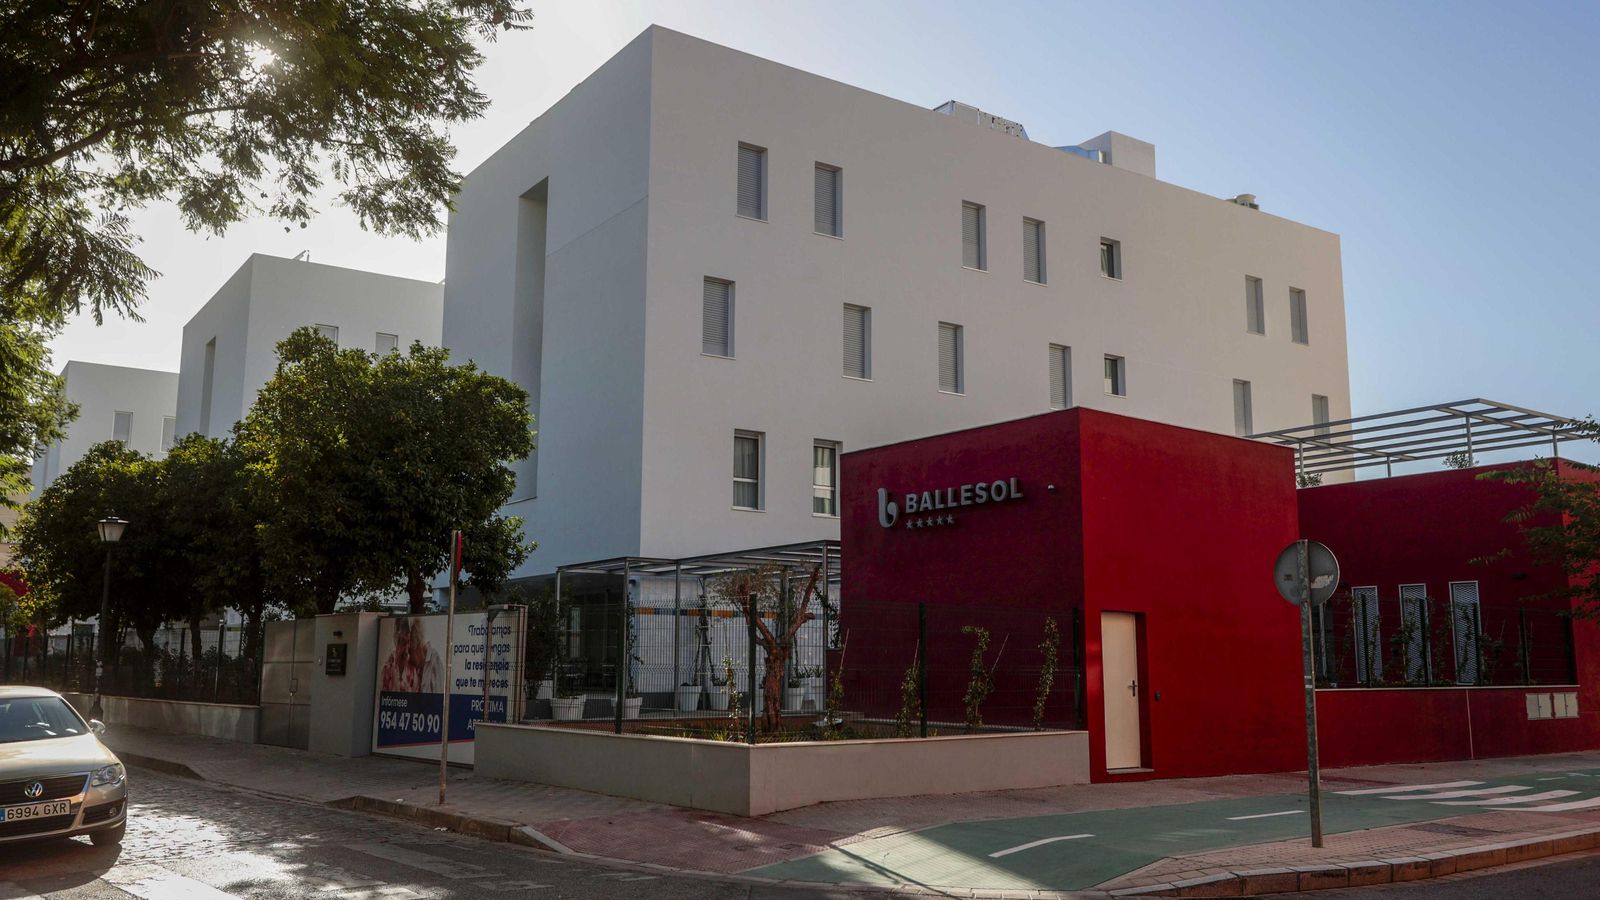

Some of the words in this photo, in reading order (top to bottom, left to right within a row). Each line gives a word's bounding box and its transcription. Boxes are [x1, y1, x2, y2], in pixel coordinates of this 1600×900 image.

[905, 477, 1023, 513] BALLESOL
[468, 624, 511, 637] Trabaamos
[454, 645, 469, 656] para
[471, 644, 484, 655] que
[465, 659, 471, 670] la
[473, 659, 509, 671] resiencia
[456, 678, 468, 689] que
[469, 677, 477, 687] te
[381, 696, 408, 707] Infórmese
[471, 697, 504, 713] PRÓIMA
[381, 710, 397, 730] 954
[399, 712, 411, 731] 47
[412, 713, 425, 732] 50
[427, 713, 440, 733] 90
[7, 806, 39, 819] 6994
[43, 803, 66, 815] GXR
